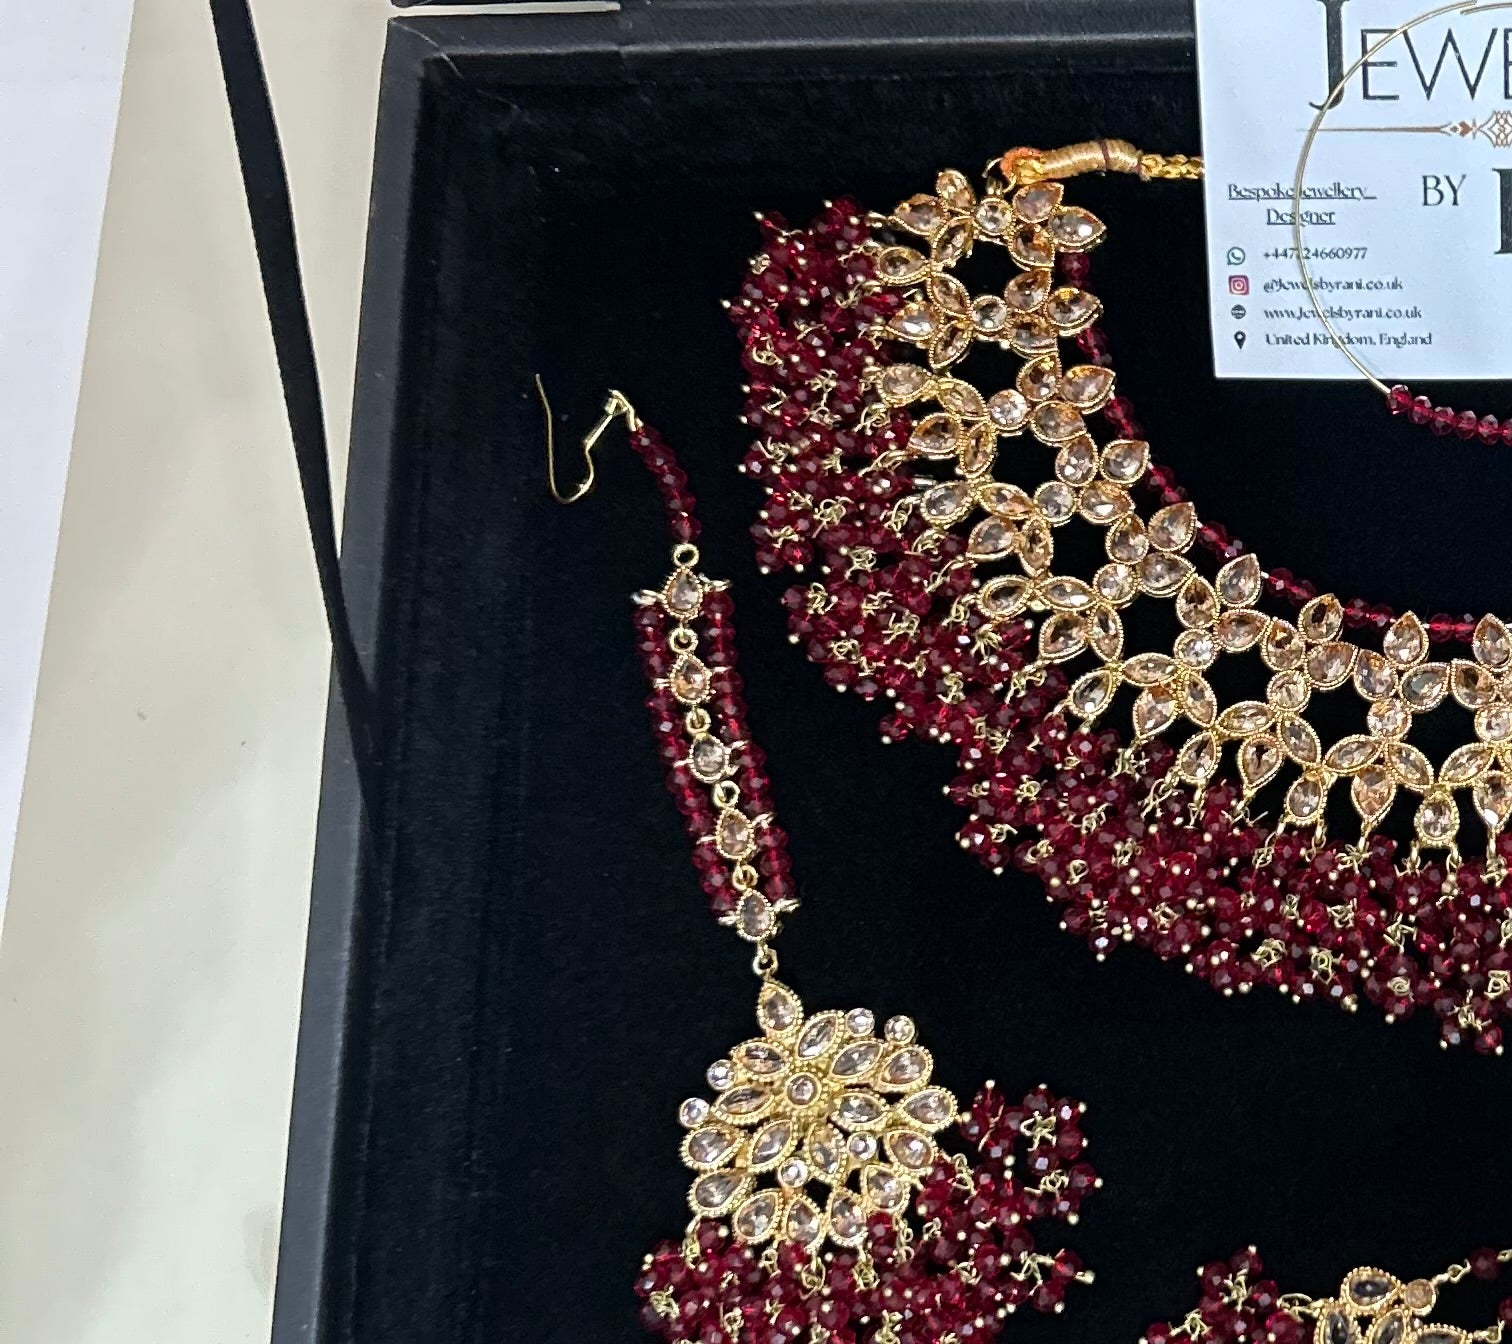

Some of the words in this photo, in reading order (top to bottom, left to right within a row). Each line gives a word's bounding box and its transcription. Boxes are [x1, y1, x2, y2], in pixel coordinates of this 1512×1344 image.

[1228, 183, 1295, 202] Bespoke
[1295, 181, 1368, 202] ewellery
[1421, 175, 1467, 207] BY
[1266, 208, 1336, 227] Desgner
[1263, 246, 1368, 261] +44724660977
[1265, 332, 1310, 346] United
[1379, 332, 1433, 348] England
